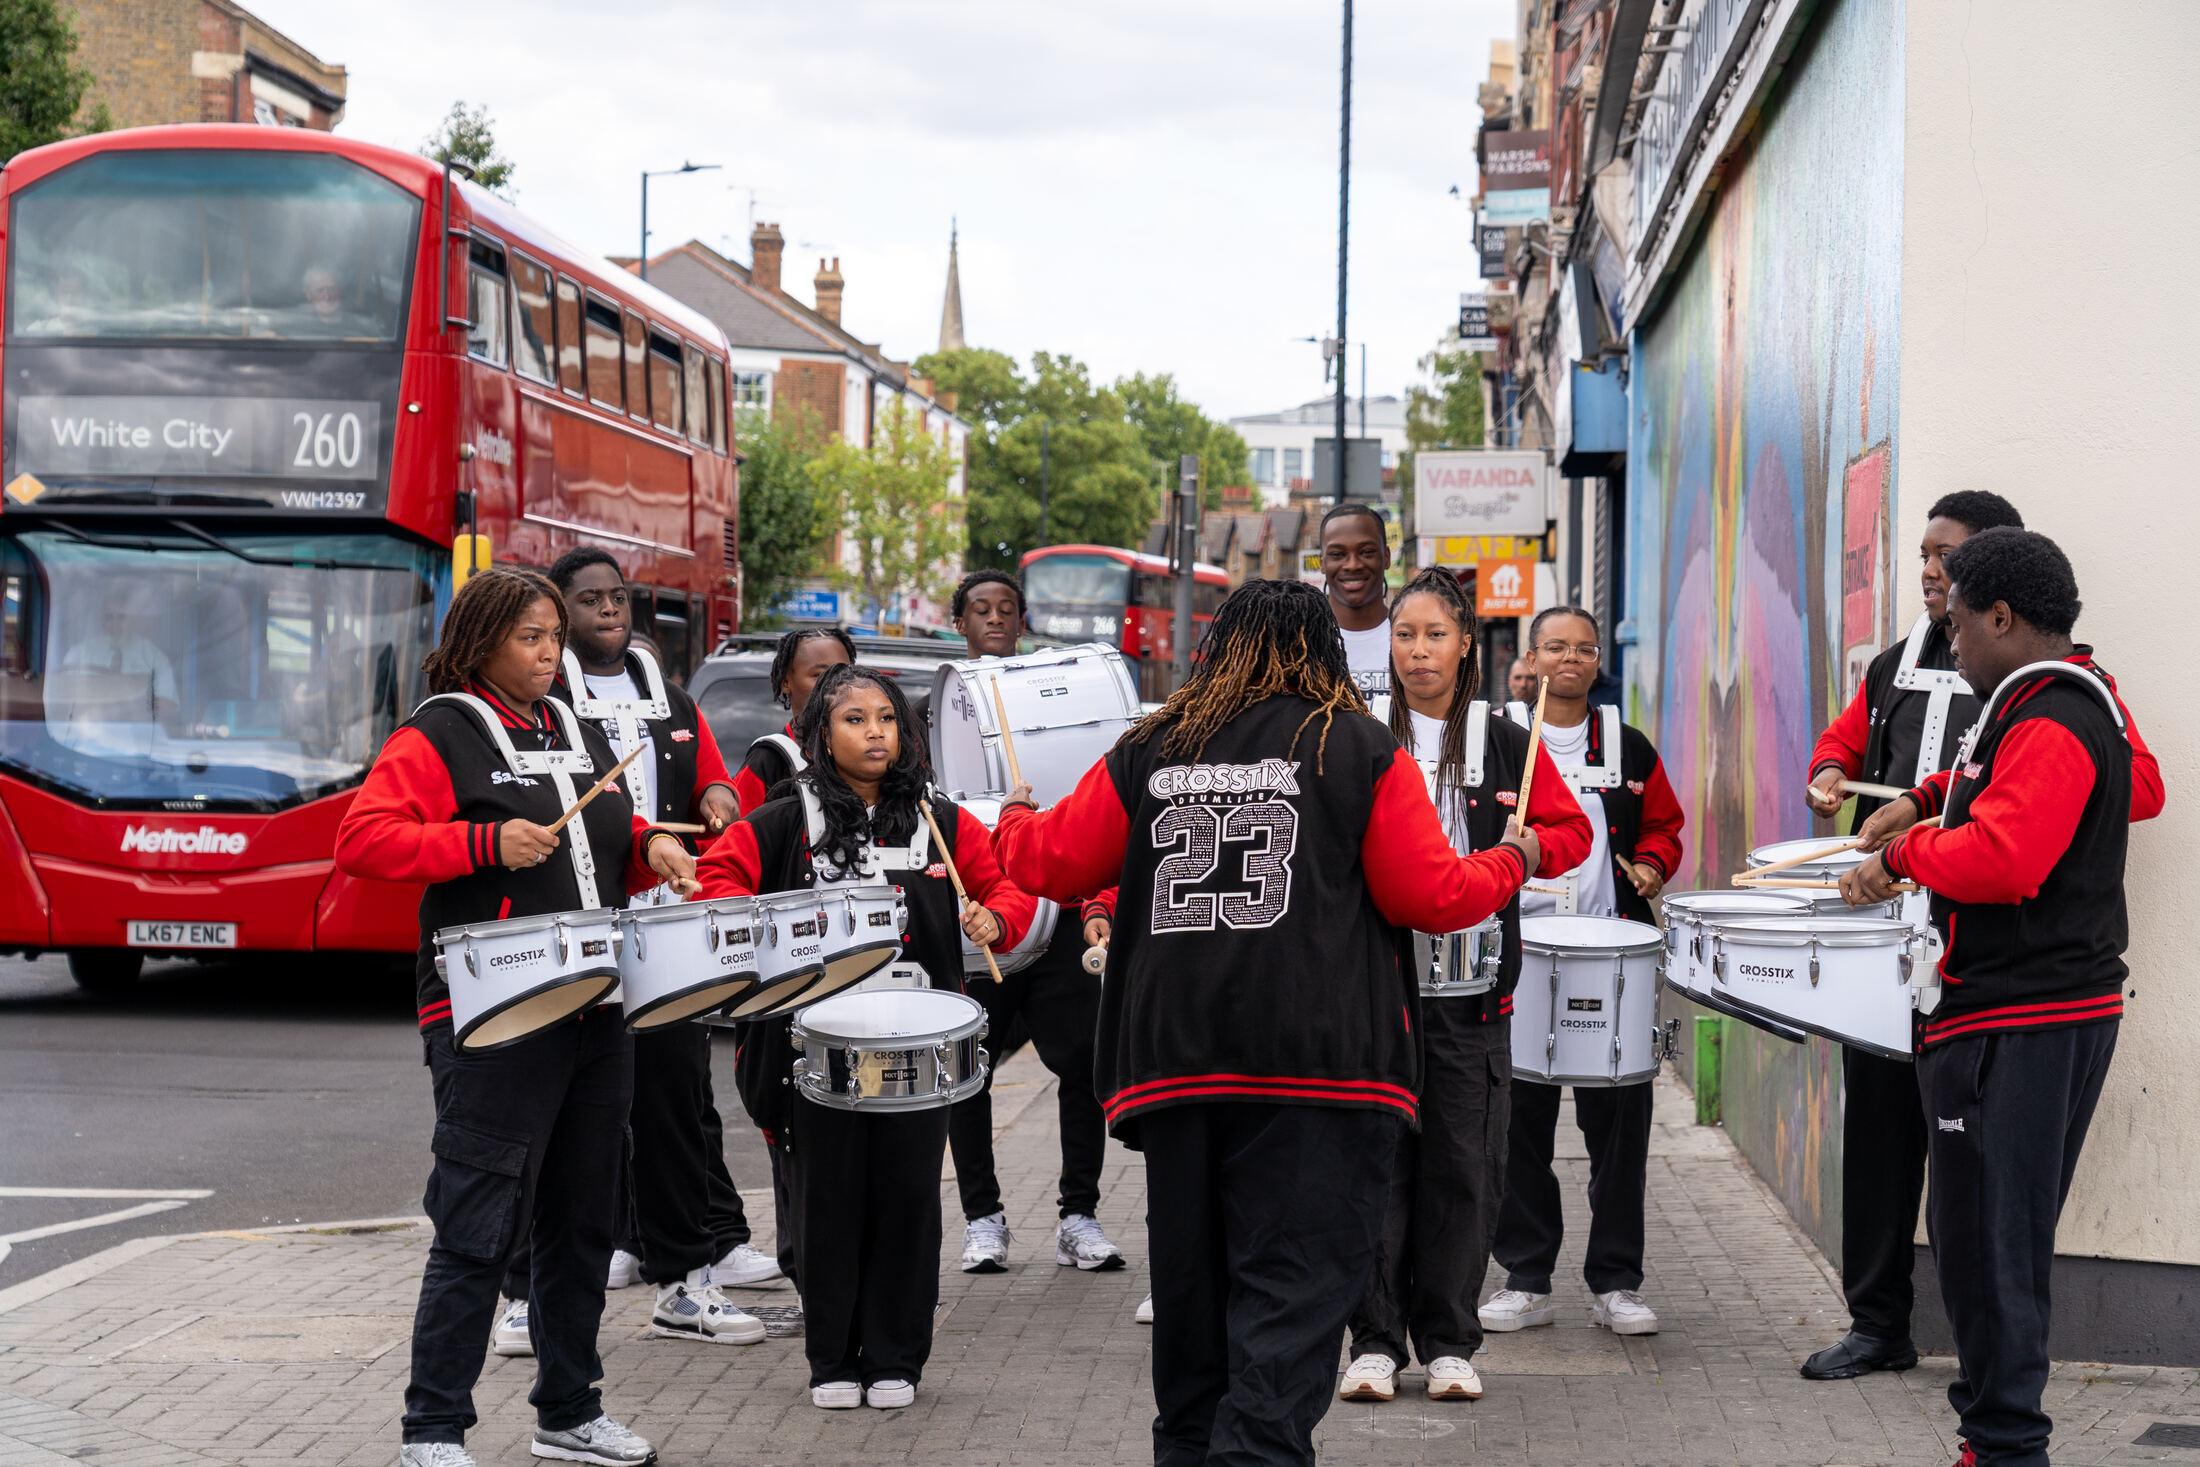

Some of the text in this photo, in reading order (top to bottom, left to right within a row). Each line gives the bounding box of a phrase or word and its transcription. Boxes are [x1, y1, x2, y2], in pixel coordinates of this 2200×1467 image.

[51, 417, 233, 457] White City
[292, 411, 362, 468] 260
[1426, 467, 1536, 489] VARANDA
[281, 490, 367, 509] VWH2397
[1149, 758, 1301, 799] CROSSTIX
[162, 801, 206, 810] VOLVO
[1178, 792, 1265, 805] DRUMLINE
[120, 824, 248, 855] Metroline
[1151, 799, 1299, 935] 23
[135, 924, 227, 943] LK67 ENC
[490, 948, 547, 967] CROSSTIX
[1739, 963, 1795, 979] CROSSTIX
[1560, 1020, 1608, 1029] CROSSTIX
[874, 1048, 926, 1061] CROSSTIX
